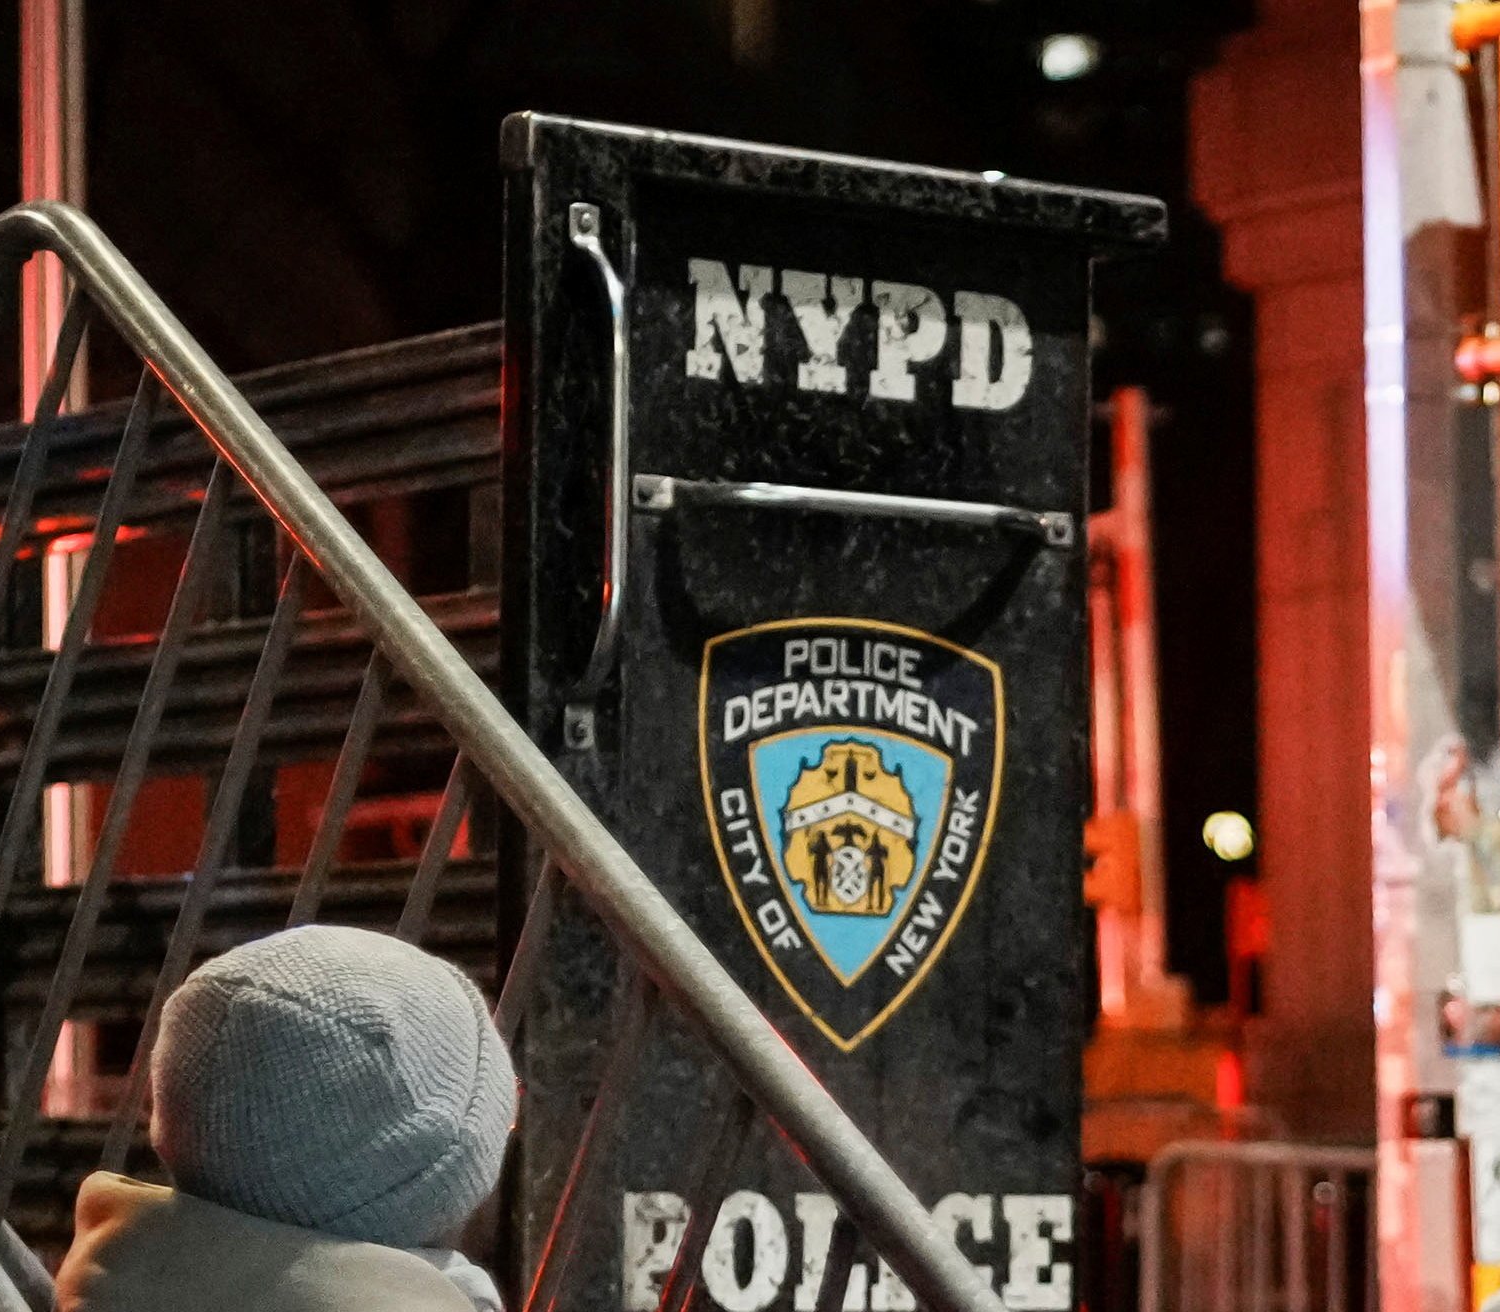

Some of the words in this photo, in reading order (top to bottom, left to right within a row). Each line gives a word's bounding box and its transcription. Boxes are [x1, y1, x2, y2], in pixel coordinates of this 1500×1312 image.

[686, 257, 1033, 411] NYPD
[724, 678, 978, 757] DEPARTMENT
[784, 637, 922, 691] POLICE
[720, 787, 770, 885] CITY
[756, 899, 804, 950] OF
[885, 889, 944, 978] NEW
[932, 785, 980, 882] YORK
